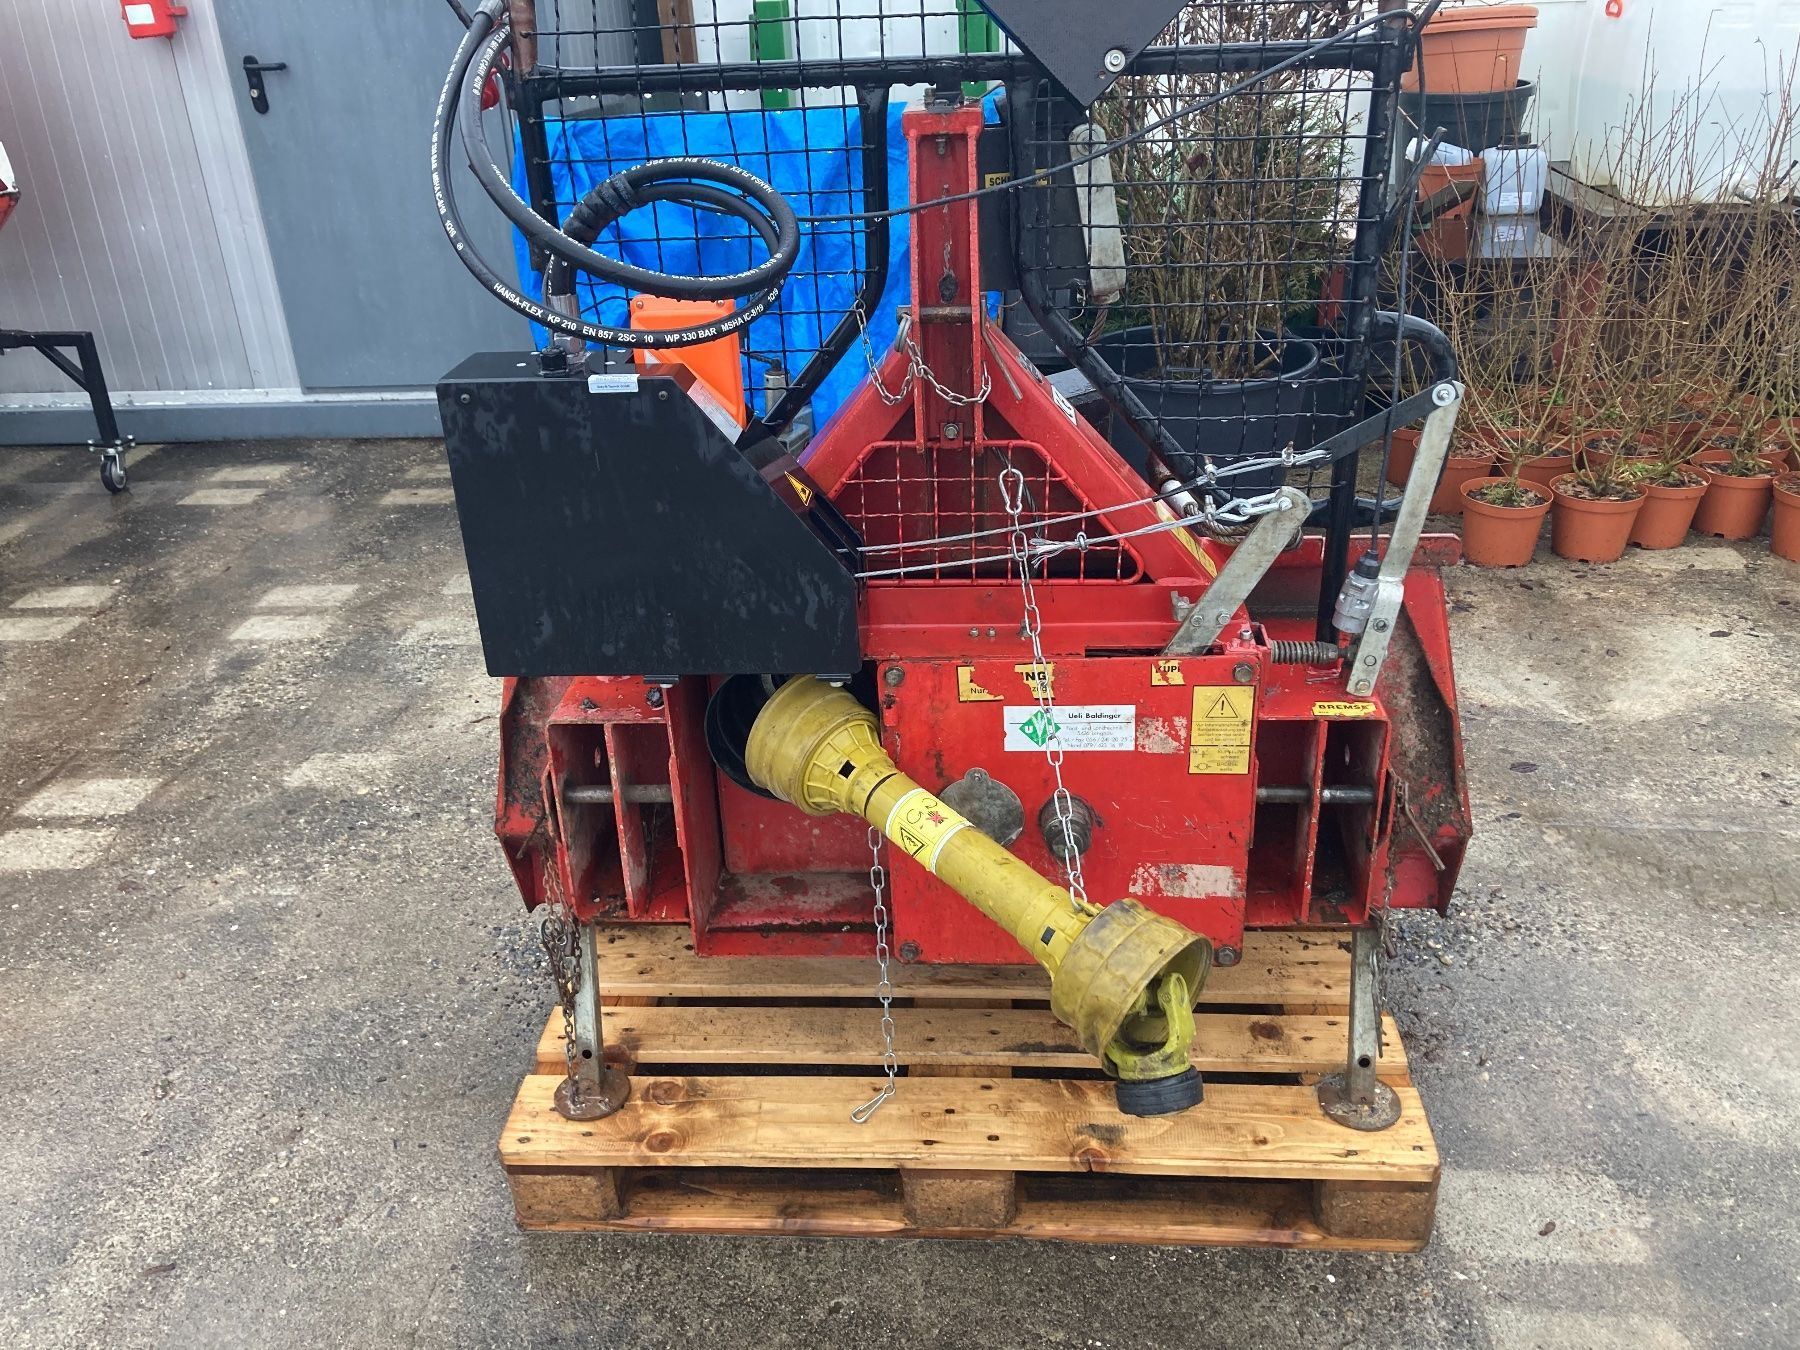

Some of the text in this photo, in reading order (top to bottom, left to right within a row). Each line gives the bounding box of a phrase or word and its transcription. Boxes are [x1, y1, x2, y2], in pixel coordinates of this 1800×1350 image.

[493, 282, 544, 318] HANSA-FLEX
[547, 313, 561, 325] KP
[561, 319, 577, 331] 210
[582, 325, 596, 337] EN
[597, 329, 614, 340] 857
[617, 332, 637, 342] 2SC
[643, 334, 654, 343] 10
[664, 334, 680, 343] WP
[681, 331, 697, 342] 330
[697, 327, 718, 339] BAR
[720, 318, 744, 332] MSHA
[743, 303, 764, 322] IC-8/19
[1085, 712, 1121, 720] Baldinger
